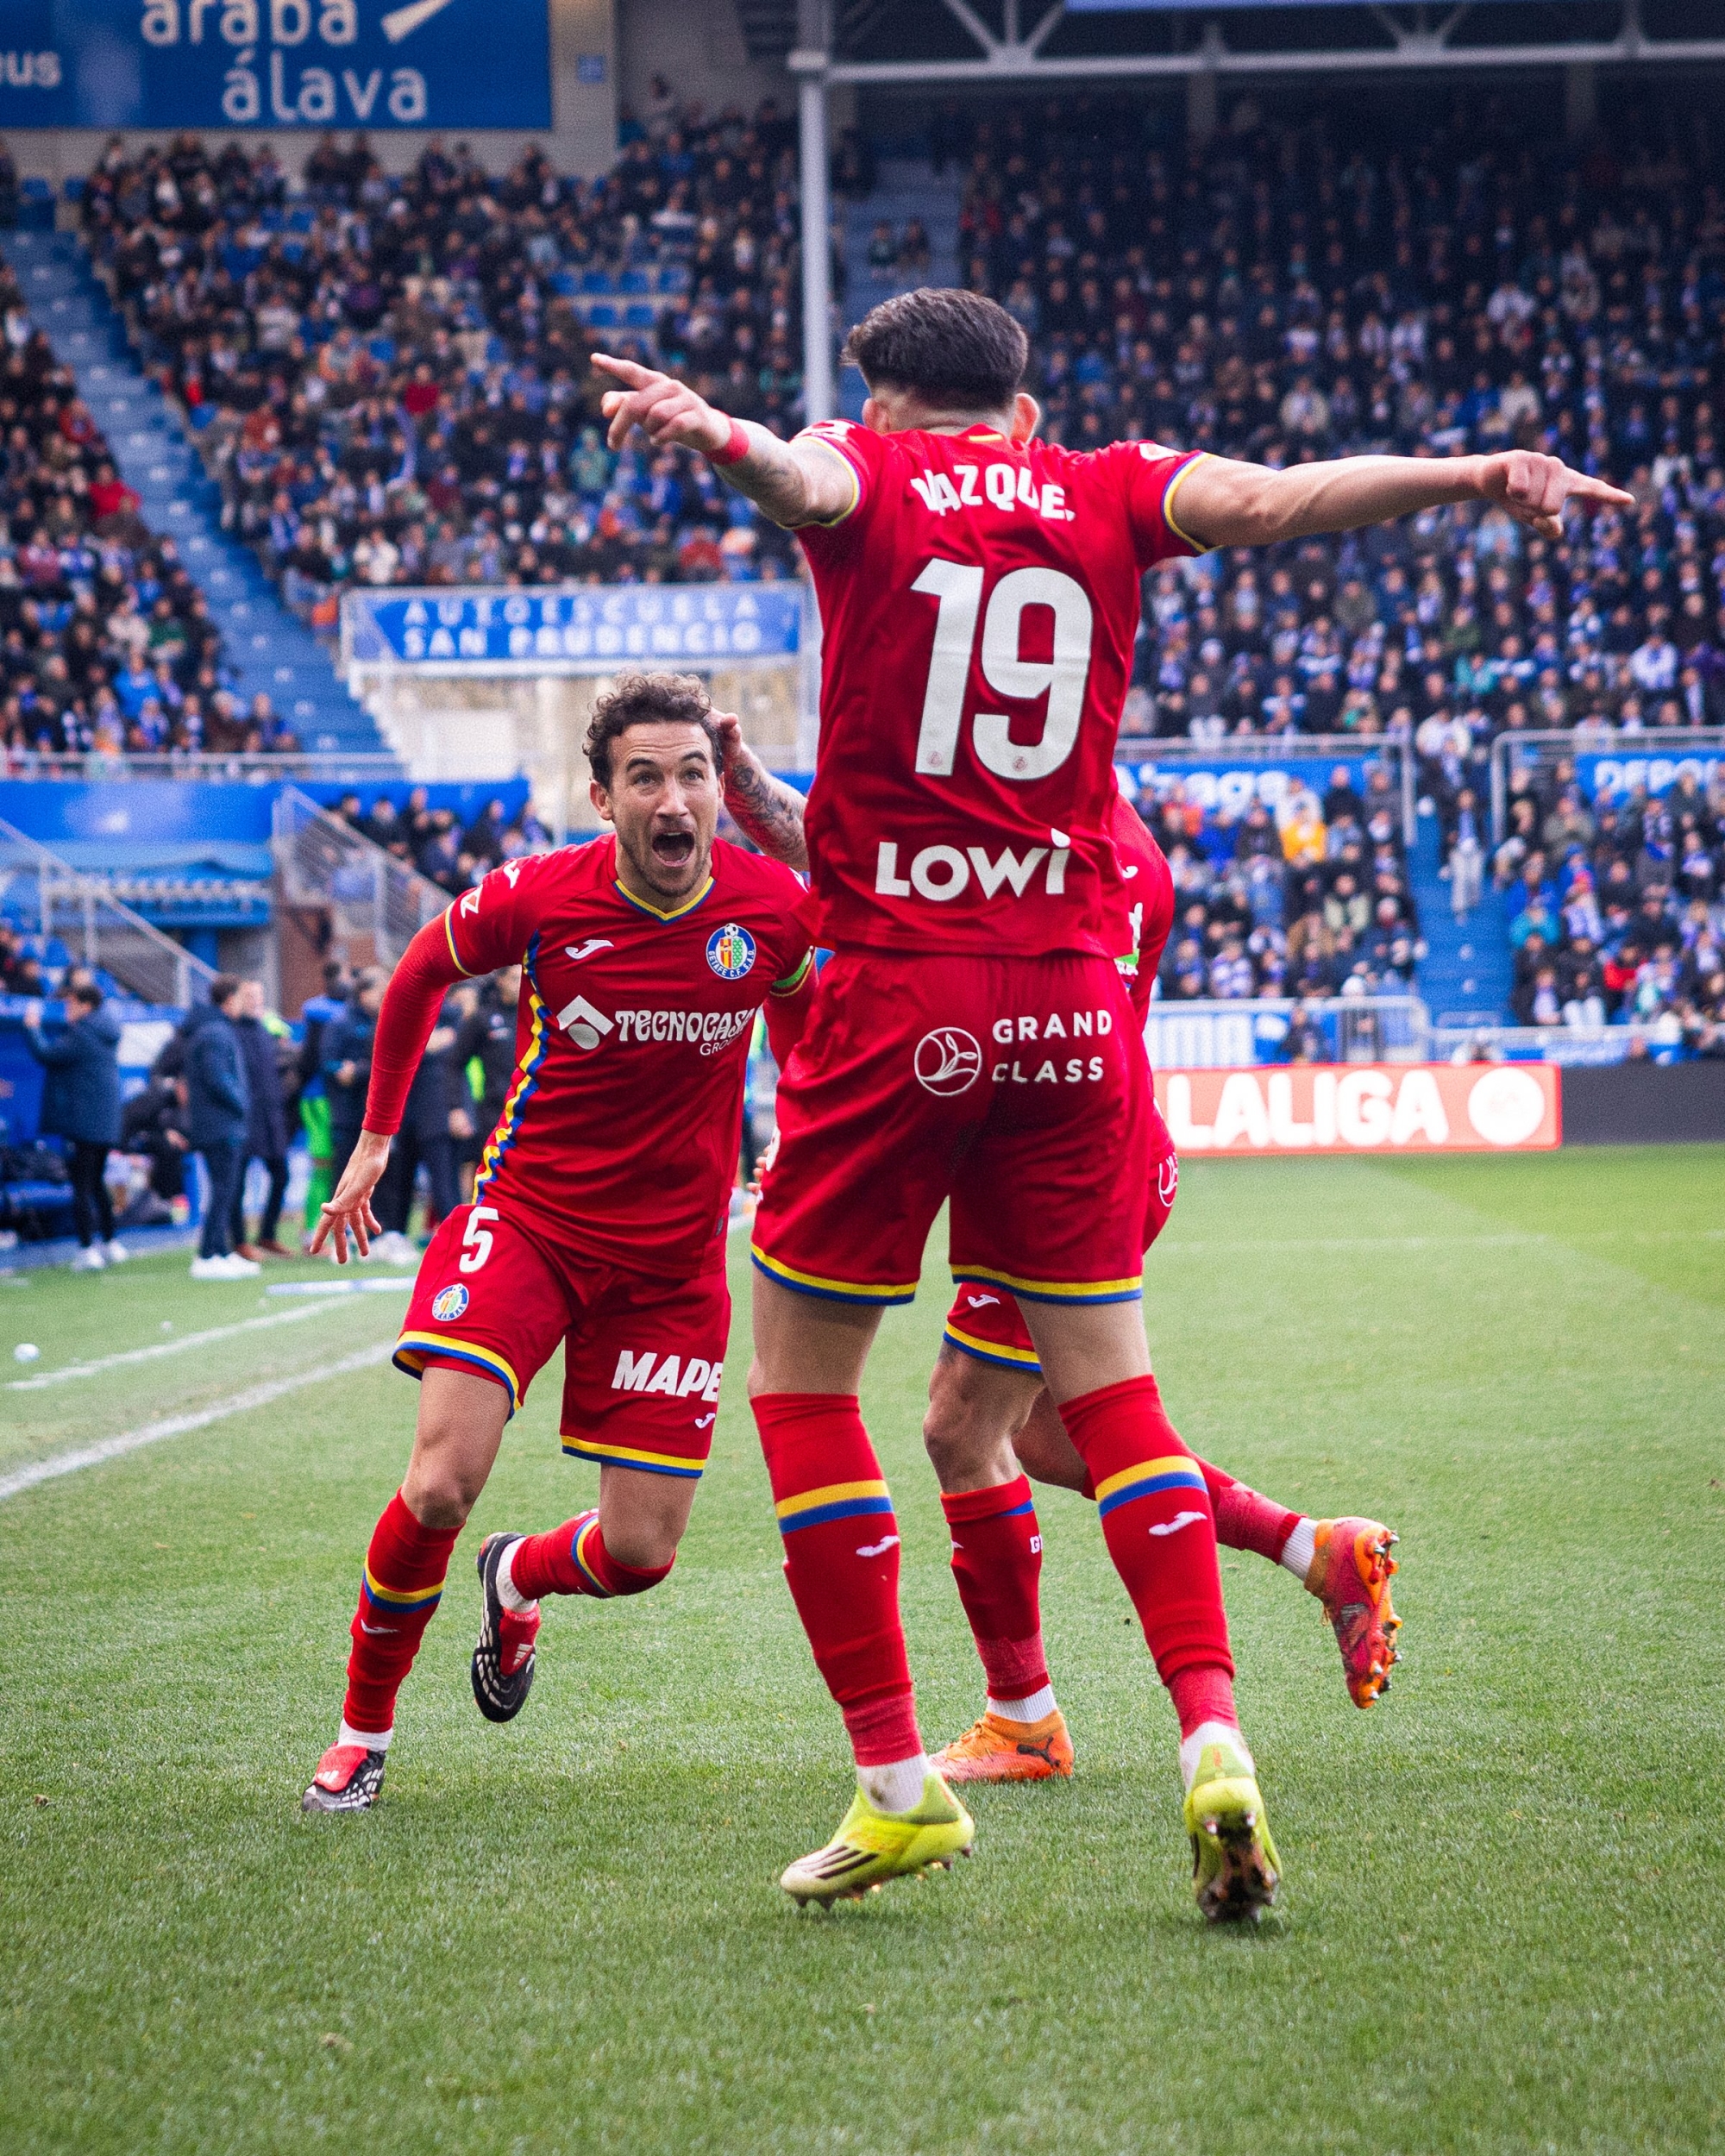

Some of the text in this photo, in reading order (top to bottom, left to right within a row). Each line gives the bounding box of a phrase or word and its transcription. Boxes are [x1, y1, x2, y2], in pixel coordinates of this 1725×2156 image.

[0, 51, 62, 88] us
[222, 48, 429, 122] álava
[910, 463, 1076, 523] VAZQUE
[910, 558, 1094, 780] 19
[708, 950, 728, 976] GETAFE
[992, 1009, 1113, 1044] GRAND
[991, 1056, 1104, 1083] CLASS
[1166, 1069, 1450, 1147] LALIGA
[459, 1206, 499, 1273] 5
